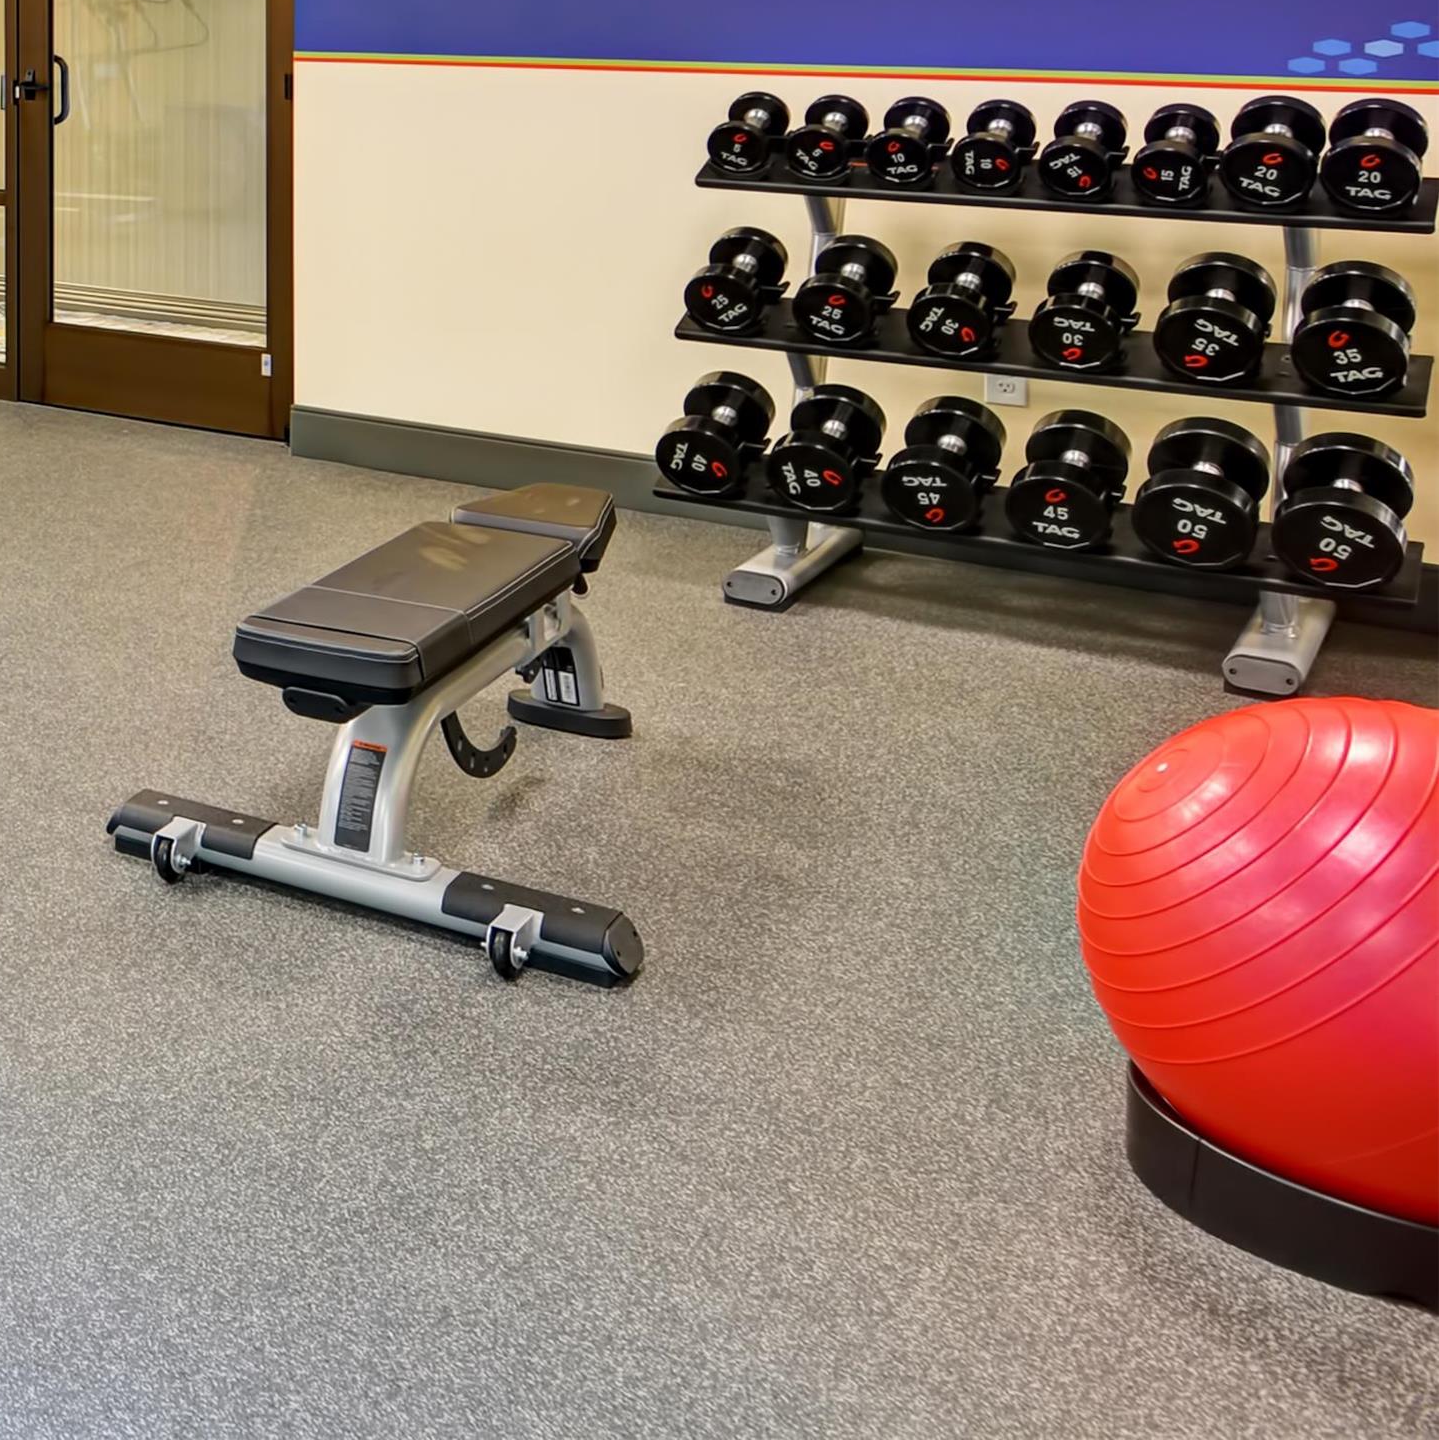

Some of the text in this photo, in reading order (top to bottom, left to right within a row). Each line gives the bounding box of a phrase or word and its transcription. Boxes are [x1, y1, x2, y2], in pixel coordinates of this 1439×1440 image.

[733, 144, 741, 153] 5
[811, 148, 823, 158] 5
[720, 151, 748, 166] TAG
[795, 149, 819, 171] TAG
[891, 153, 905, 163] 10
[965, 151, 975, 175] TAG
[980, 159, 992, 170] 10
[1049, 153, 1081, 170] TAG
[886, 164, 918, 175] TAG
[1067, 166, 1083, 178] 15
[1160, 170, 1174, 181] 15
[1178, 165, 1193, 191] TAG
[1254, 165, 1278, 180] 20
[1358, 170, 1382, 184] 20
[1239, 177, 1281, 197] TAG
[1345, 186, 1392, 200] TAG
[711, 294, 729, 310] 25
[717, 303, 748, 323] TAG
[821, 305, 843, 320] 25
[919, 307, 945, 332] TAG
[809, 315, 845, 336] TAG
[941, 318, 959, 335] 30
[1053, 316, 1096, 332] TAG
[1194, 318, 1239, 346] TAG
[1062, 332, 1084, 346] 30
[1191, 338, 1220, 356] 35
[1333, 348, 1362, 365] 35
[1330, 367, 1383, 383] TAG
[670, 442, 688, 471] TAG
[691, 453, 707, 472] 40
[781, 462, 802, 495] TAG
[803, 469, 822, 487] 40
[902, 476, 947, 487] TAG
[917, 492, 940, 505] 45
[1043, 505, 1069, 520] 45
[1172, 497, 1227, 525] TAG
[1032, 521, 1080, 540] TAG
[1177, 519, 1208, 540] 50
[1321, 515, 1375, 548] TAG
[1319, 537, 1353, 560] 50
